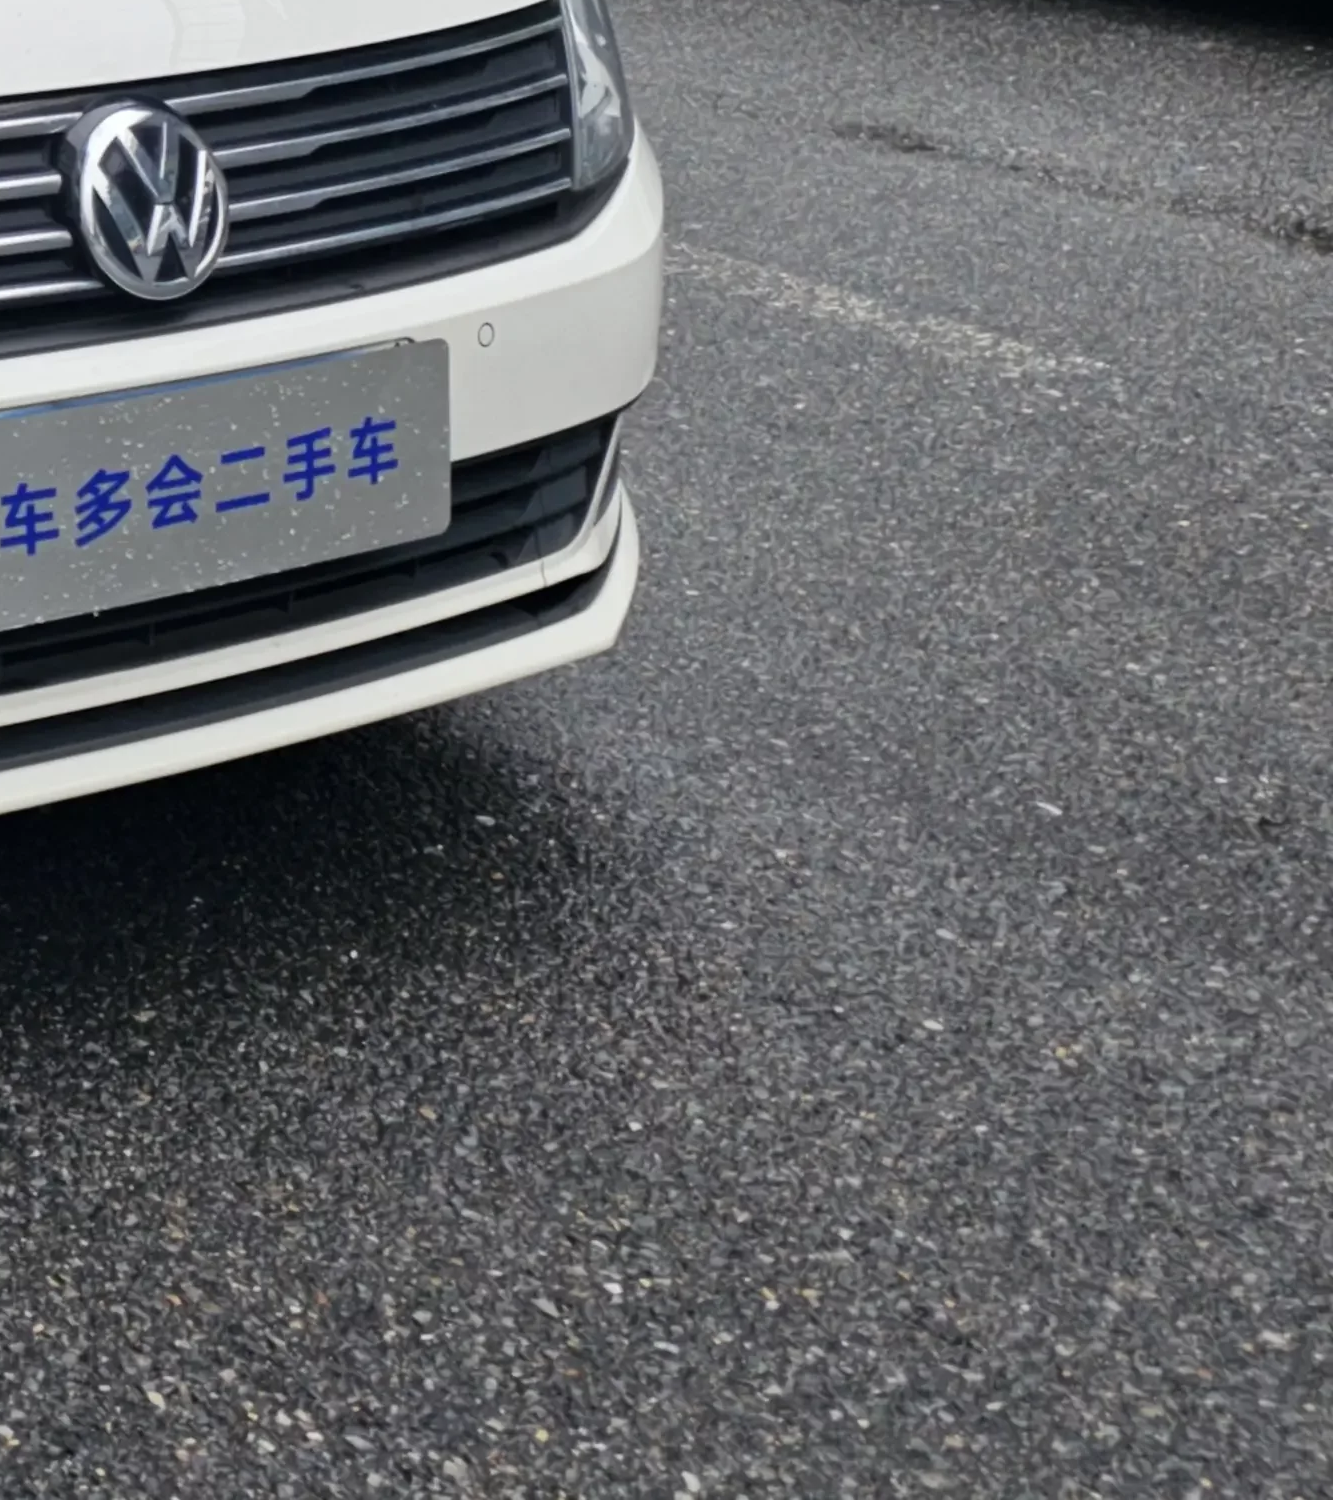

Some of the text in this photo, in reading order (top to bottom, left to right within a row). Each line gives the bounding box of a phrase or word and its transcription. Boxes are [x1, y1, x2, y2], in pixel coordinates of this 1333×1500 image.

[0, 416, 399, 556] 车多会二手车
